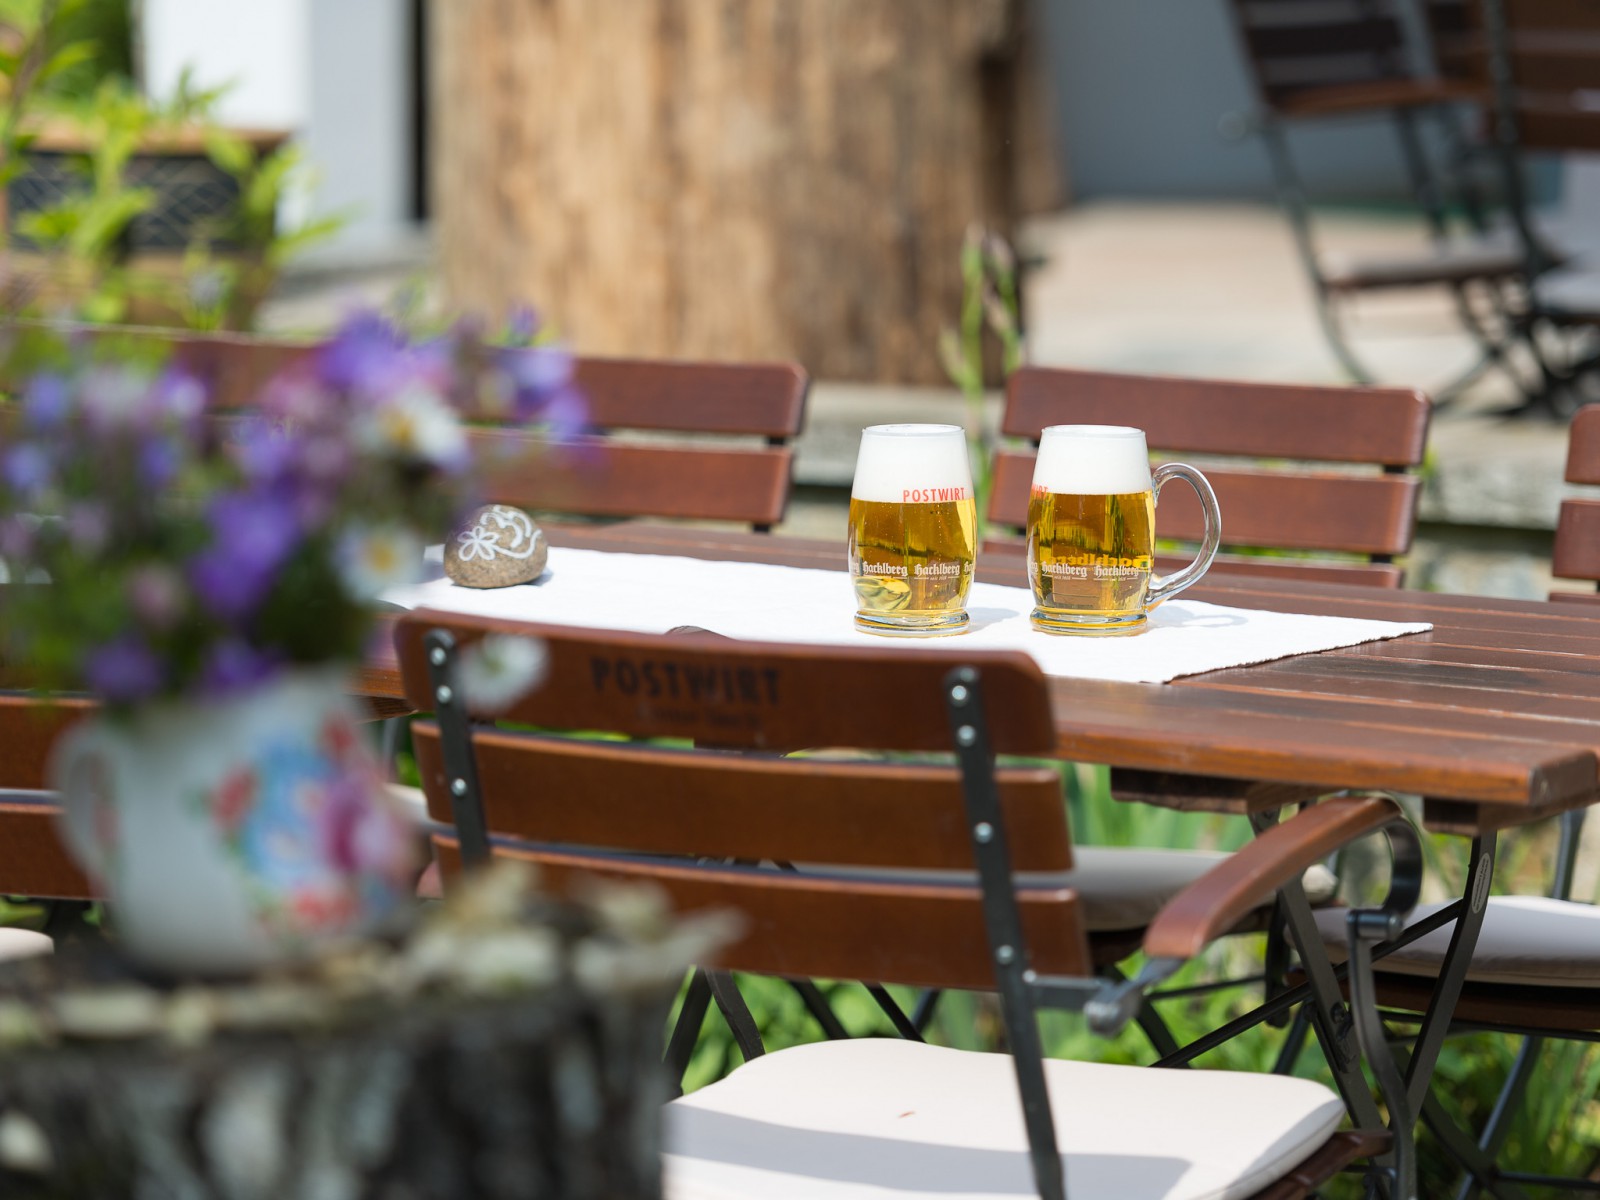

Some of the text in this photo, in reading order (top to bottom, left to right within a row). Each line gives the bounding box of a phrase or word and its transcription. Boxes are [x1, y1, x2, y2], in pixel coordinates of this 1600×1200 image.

[903, 487, 965, 503] POSTWIRT
[862, 560, 908, 577] Hacklberg
[914, 563, 960, 577] Hacklberg
[1041, 561, 1088, 577] Hacklberg
[590, 656, 780, 705] POSTWIRT
